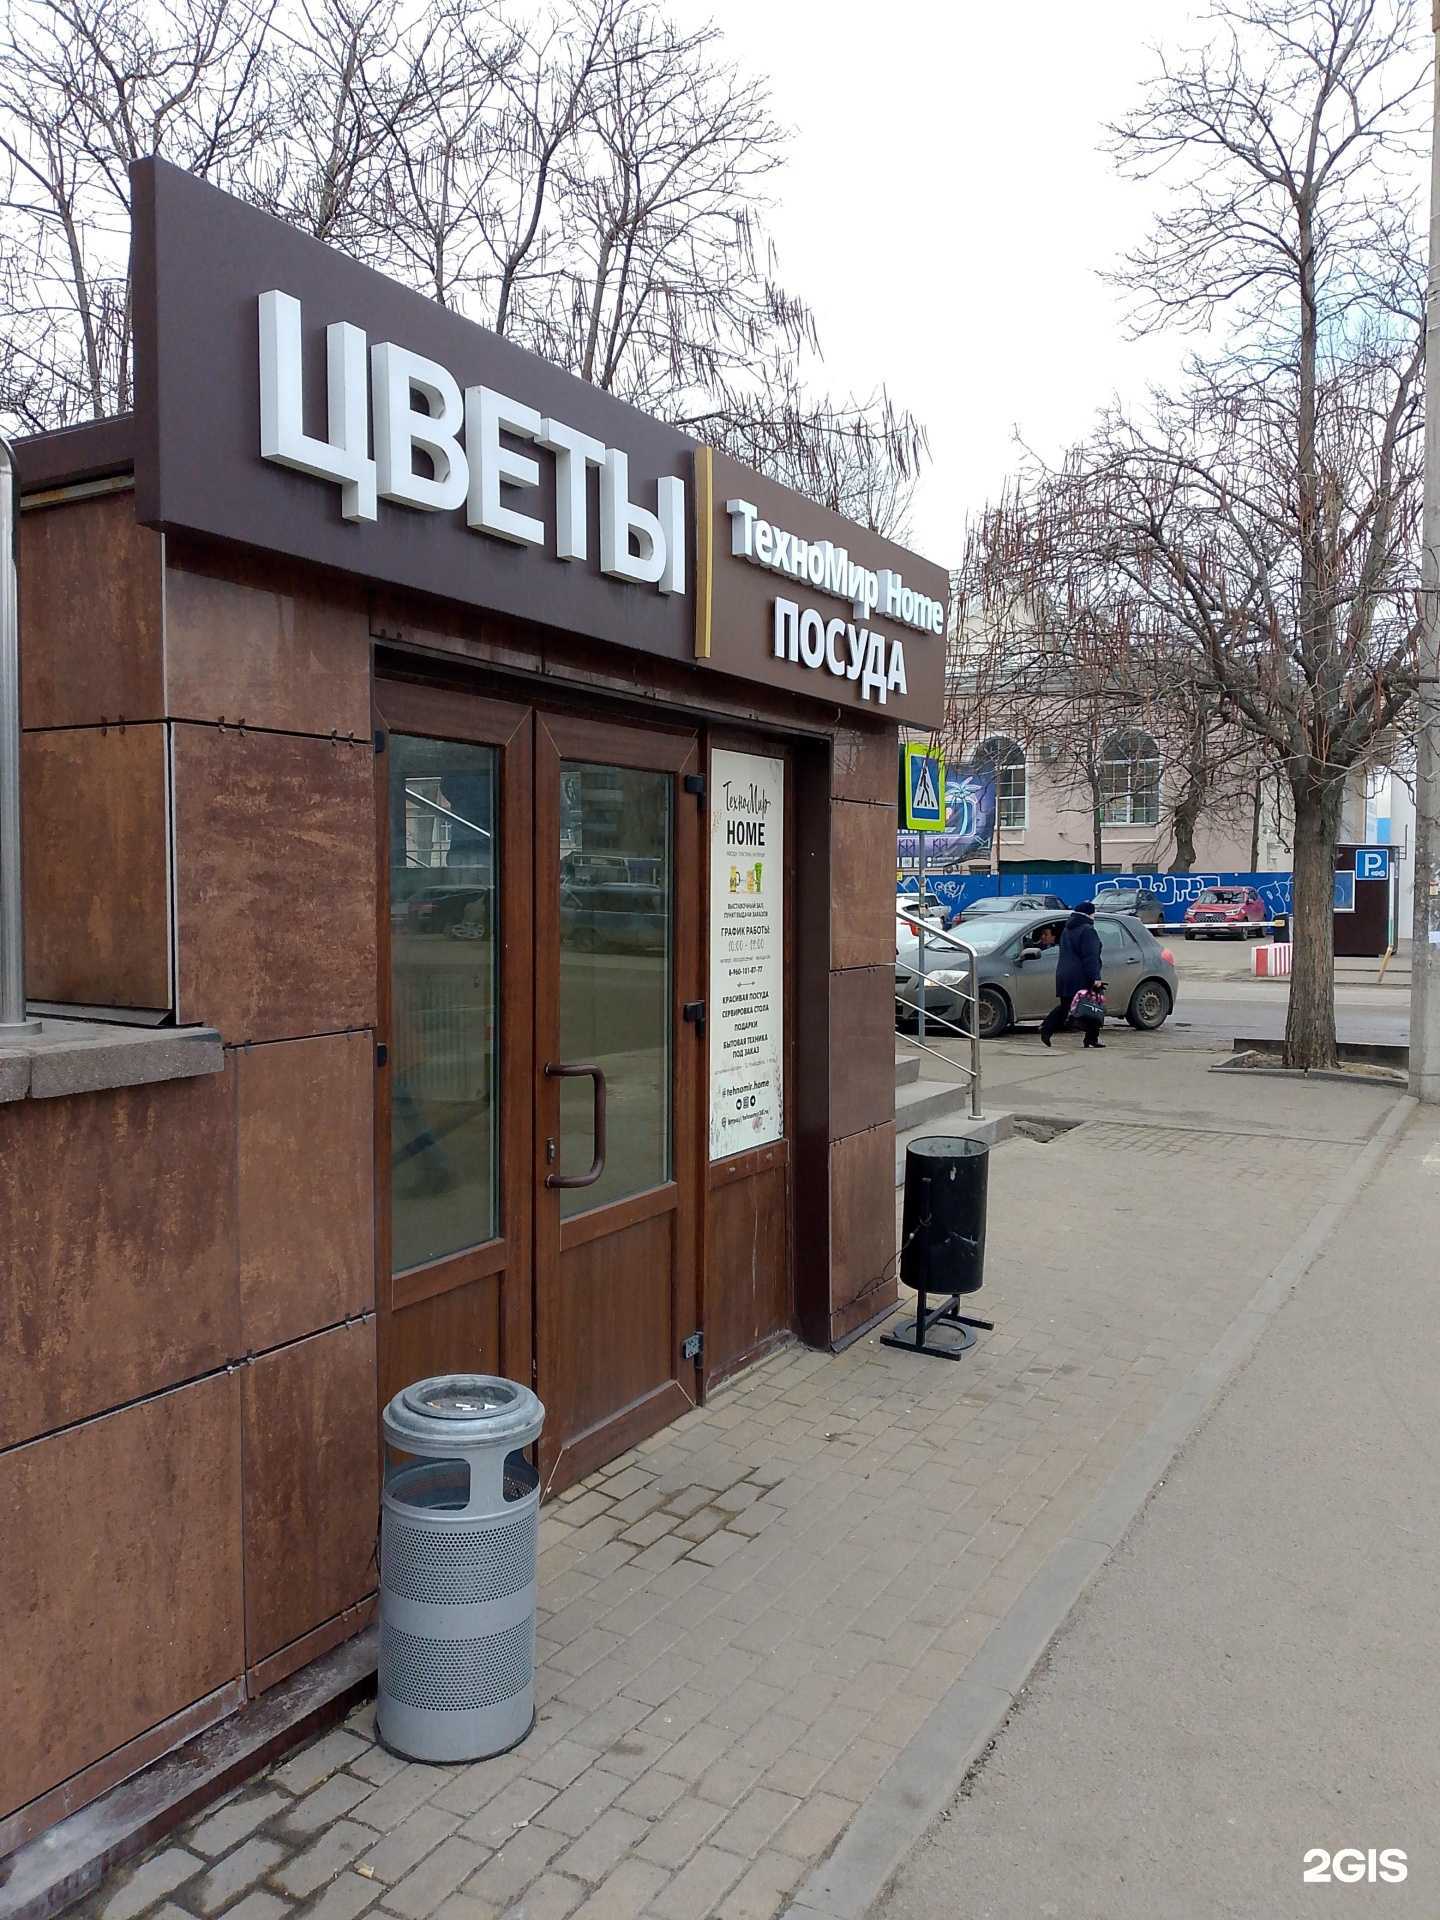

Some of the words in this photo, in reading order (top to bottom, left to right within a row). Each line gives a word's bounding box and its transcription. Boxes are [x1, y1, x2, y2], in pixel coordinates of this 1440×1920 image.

[258, 290, 686, 596] ЦВЕТЫ
[727, 499, 879, 620] ТехноМир
[876, 569, 944, 635] Home
[774, 596, 908, 705] ПОСУДА
[727, 820, 766, 847] HOME
[721, 927, 745, 937] ГРАФИК
[722, 993, 748, 1004] КРАСИВАЯ
[749, 990, 769, 1001] ПОСУДА
[722, 1007, 753, 1018] СЕРВИРОВКА
[754, 1004, 769, 1013] СТОЛА
[734, 1020, 758, 1031] ПОДАРКИ
[723, 1037, 746, 1049] БЫТОВАЯ
[747, 1033, 768, 1044] ТЕХНИКА
[732, 1049, 744, 1059] ПОД
[744, 1046, 760, 1057] ЗАКАЗ
